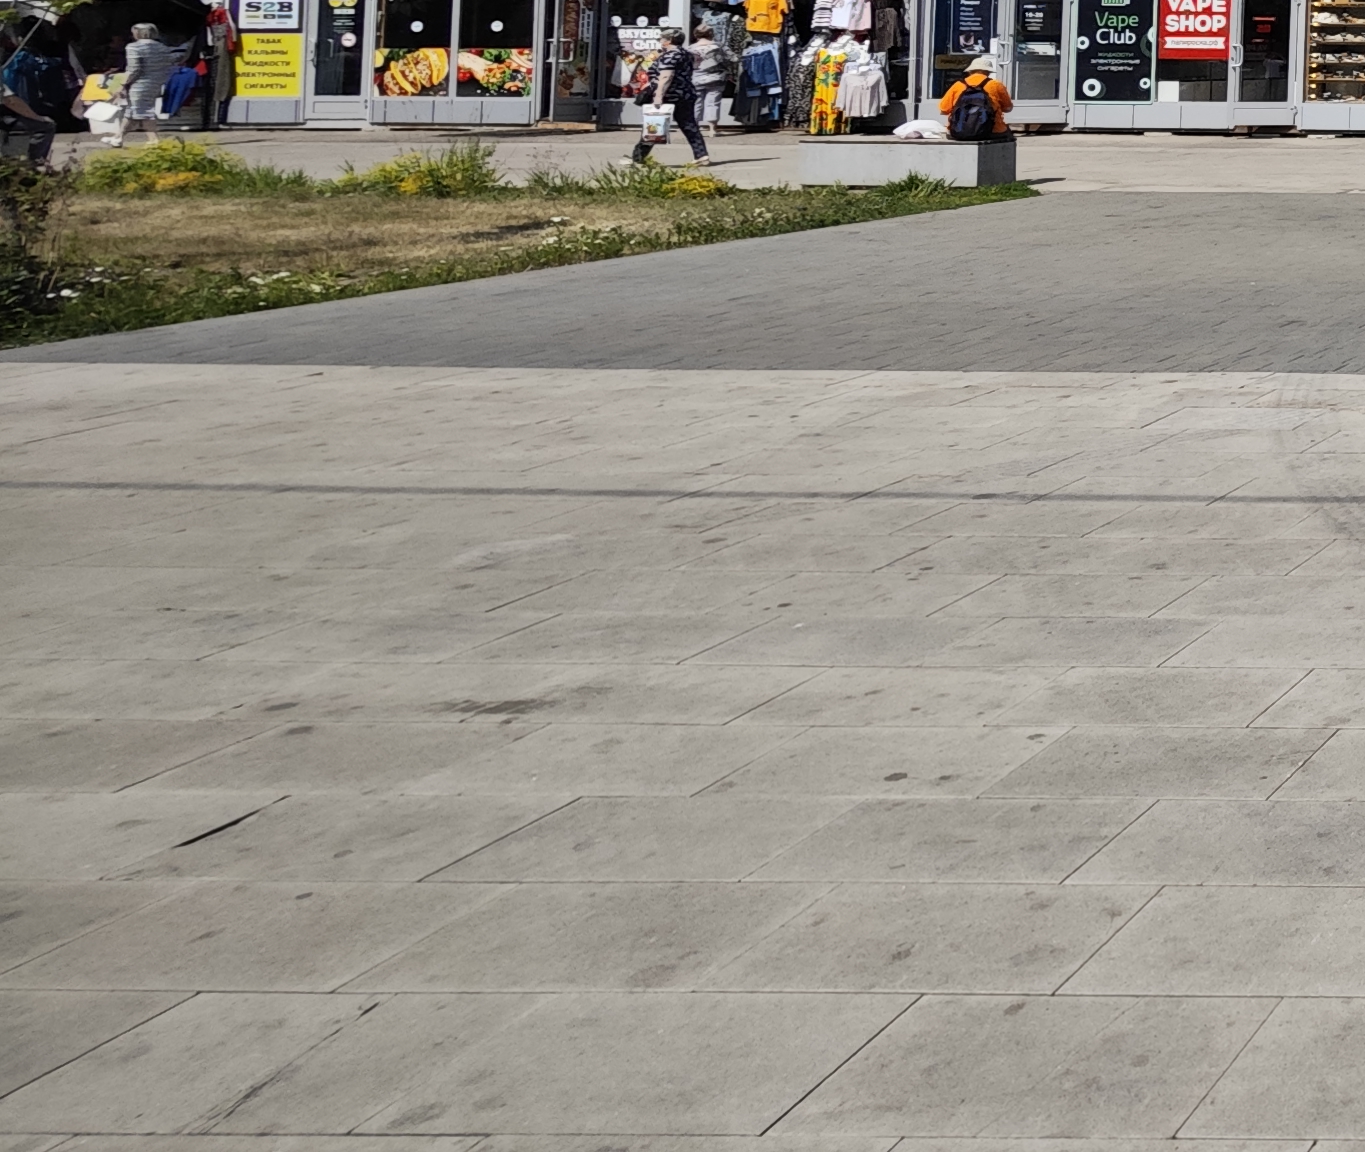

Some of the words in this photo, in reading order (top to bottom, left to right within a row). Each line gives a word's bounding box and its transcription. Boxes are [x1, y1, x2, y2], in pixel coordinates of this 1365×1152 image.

[245, 1, 294, 13] S2B
[1094, 11, 1140, 32] Vape
[1164, 14, 1227, 33] SHOP
[1095, 28, 1137, 45] Club
